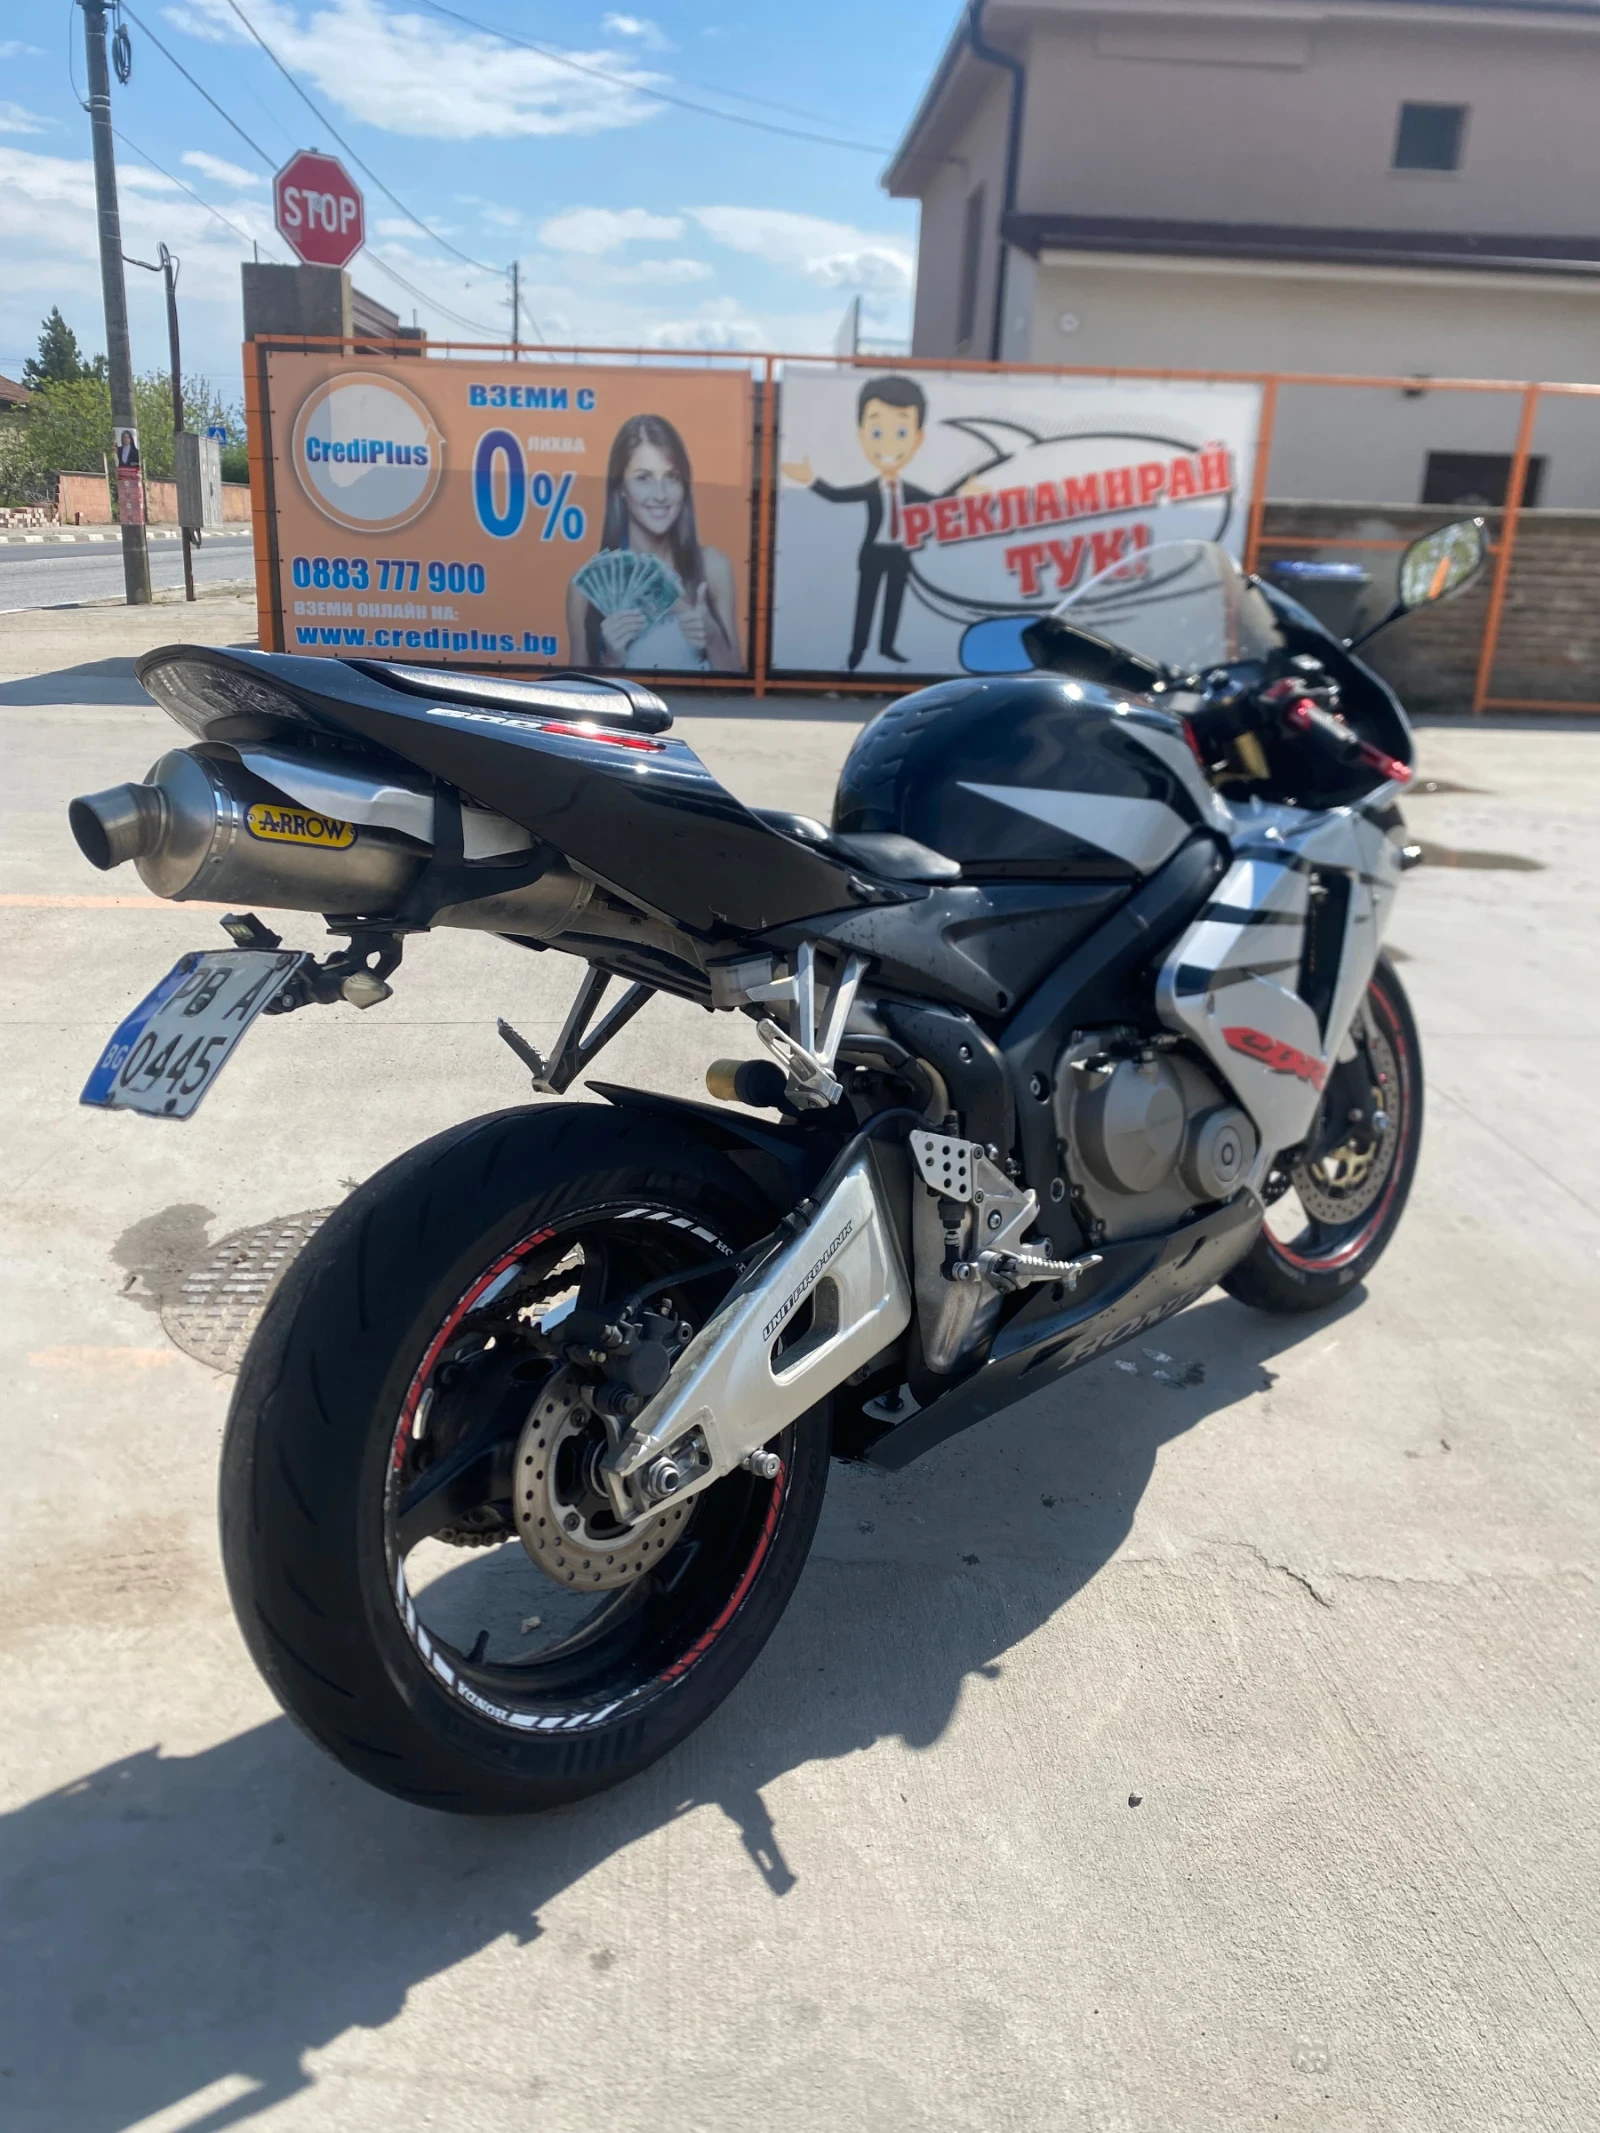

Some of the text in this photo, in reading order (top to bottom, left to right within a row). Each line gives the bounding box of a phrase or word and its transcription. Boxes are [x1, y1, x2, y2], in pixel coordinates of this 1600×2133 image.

[284, 186, 357, 235] STOP
[468, 384, 596, 412] ВЗЕМИ С
[305, 436, 429, 466] CrediPlus
[527, 435, 586, 454] ЛИХВА
[902, 440, 1233, 550] РЕКЛАМИРАЙ
[292, 555, 487, 596] 0883 777 900
[1005, 523, 1150, 597] ТУК!
[294, 601, 461, 622] ВЗЕМИ ОНЛАЙН НА:
[294, 626, 559, 657] www.crediplus.bg
[258, 810, 347, 841] ARROW
[221, 964, 277, 1022] A
[100, 1043, 130, 1070] BG
[119, 1031, 228, 1096] 0445
[457, 1679, 509, 1721] HONDA
